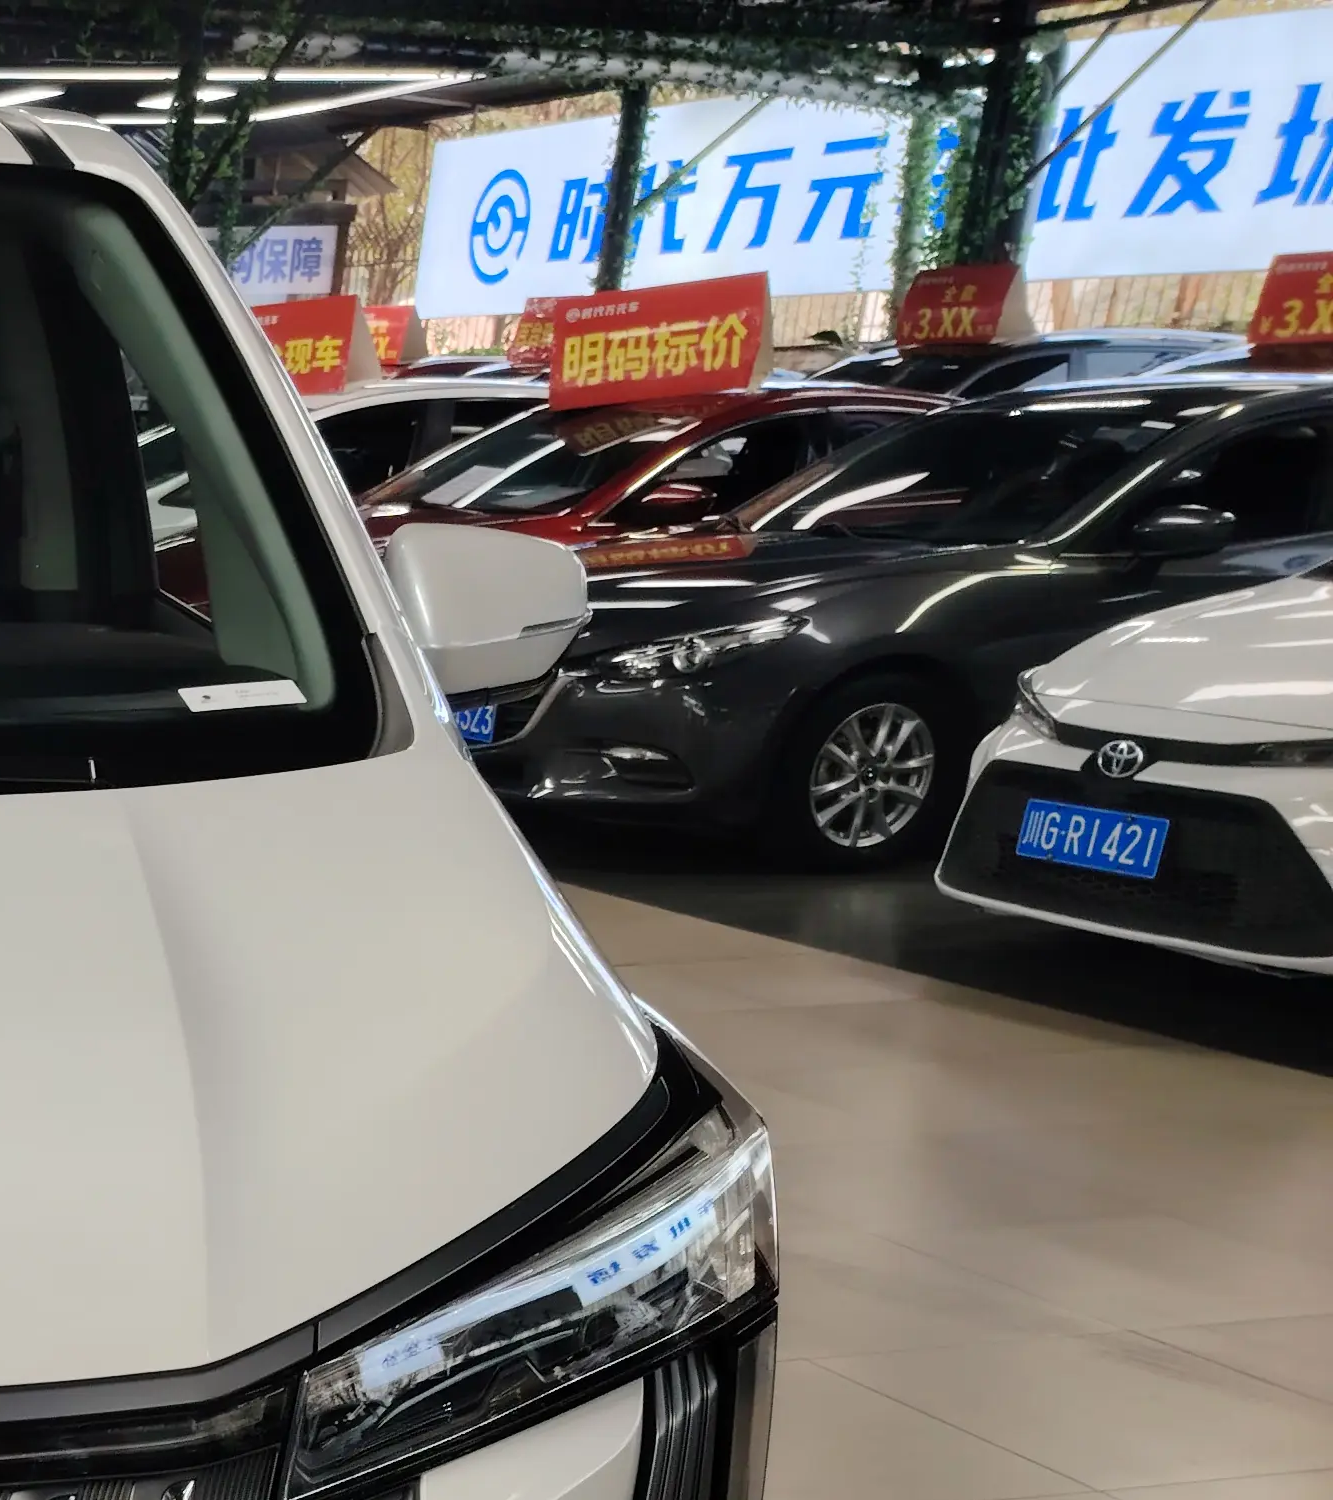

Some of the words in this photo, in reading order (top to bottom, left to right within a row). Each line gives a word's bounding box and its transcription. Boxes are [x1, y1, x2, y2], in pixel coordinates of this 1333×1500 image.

[274, 335, 343, 375] 现车
[561, 312, 749, 387] 明码标价
[1021, 810, 1158, 868] 川G·R1421
